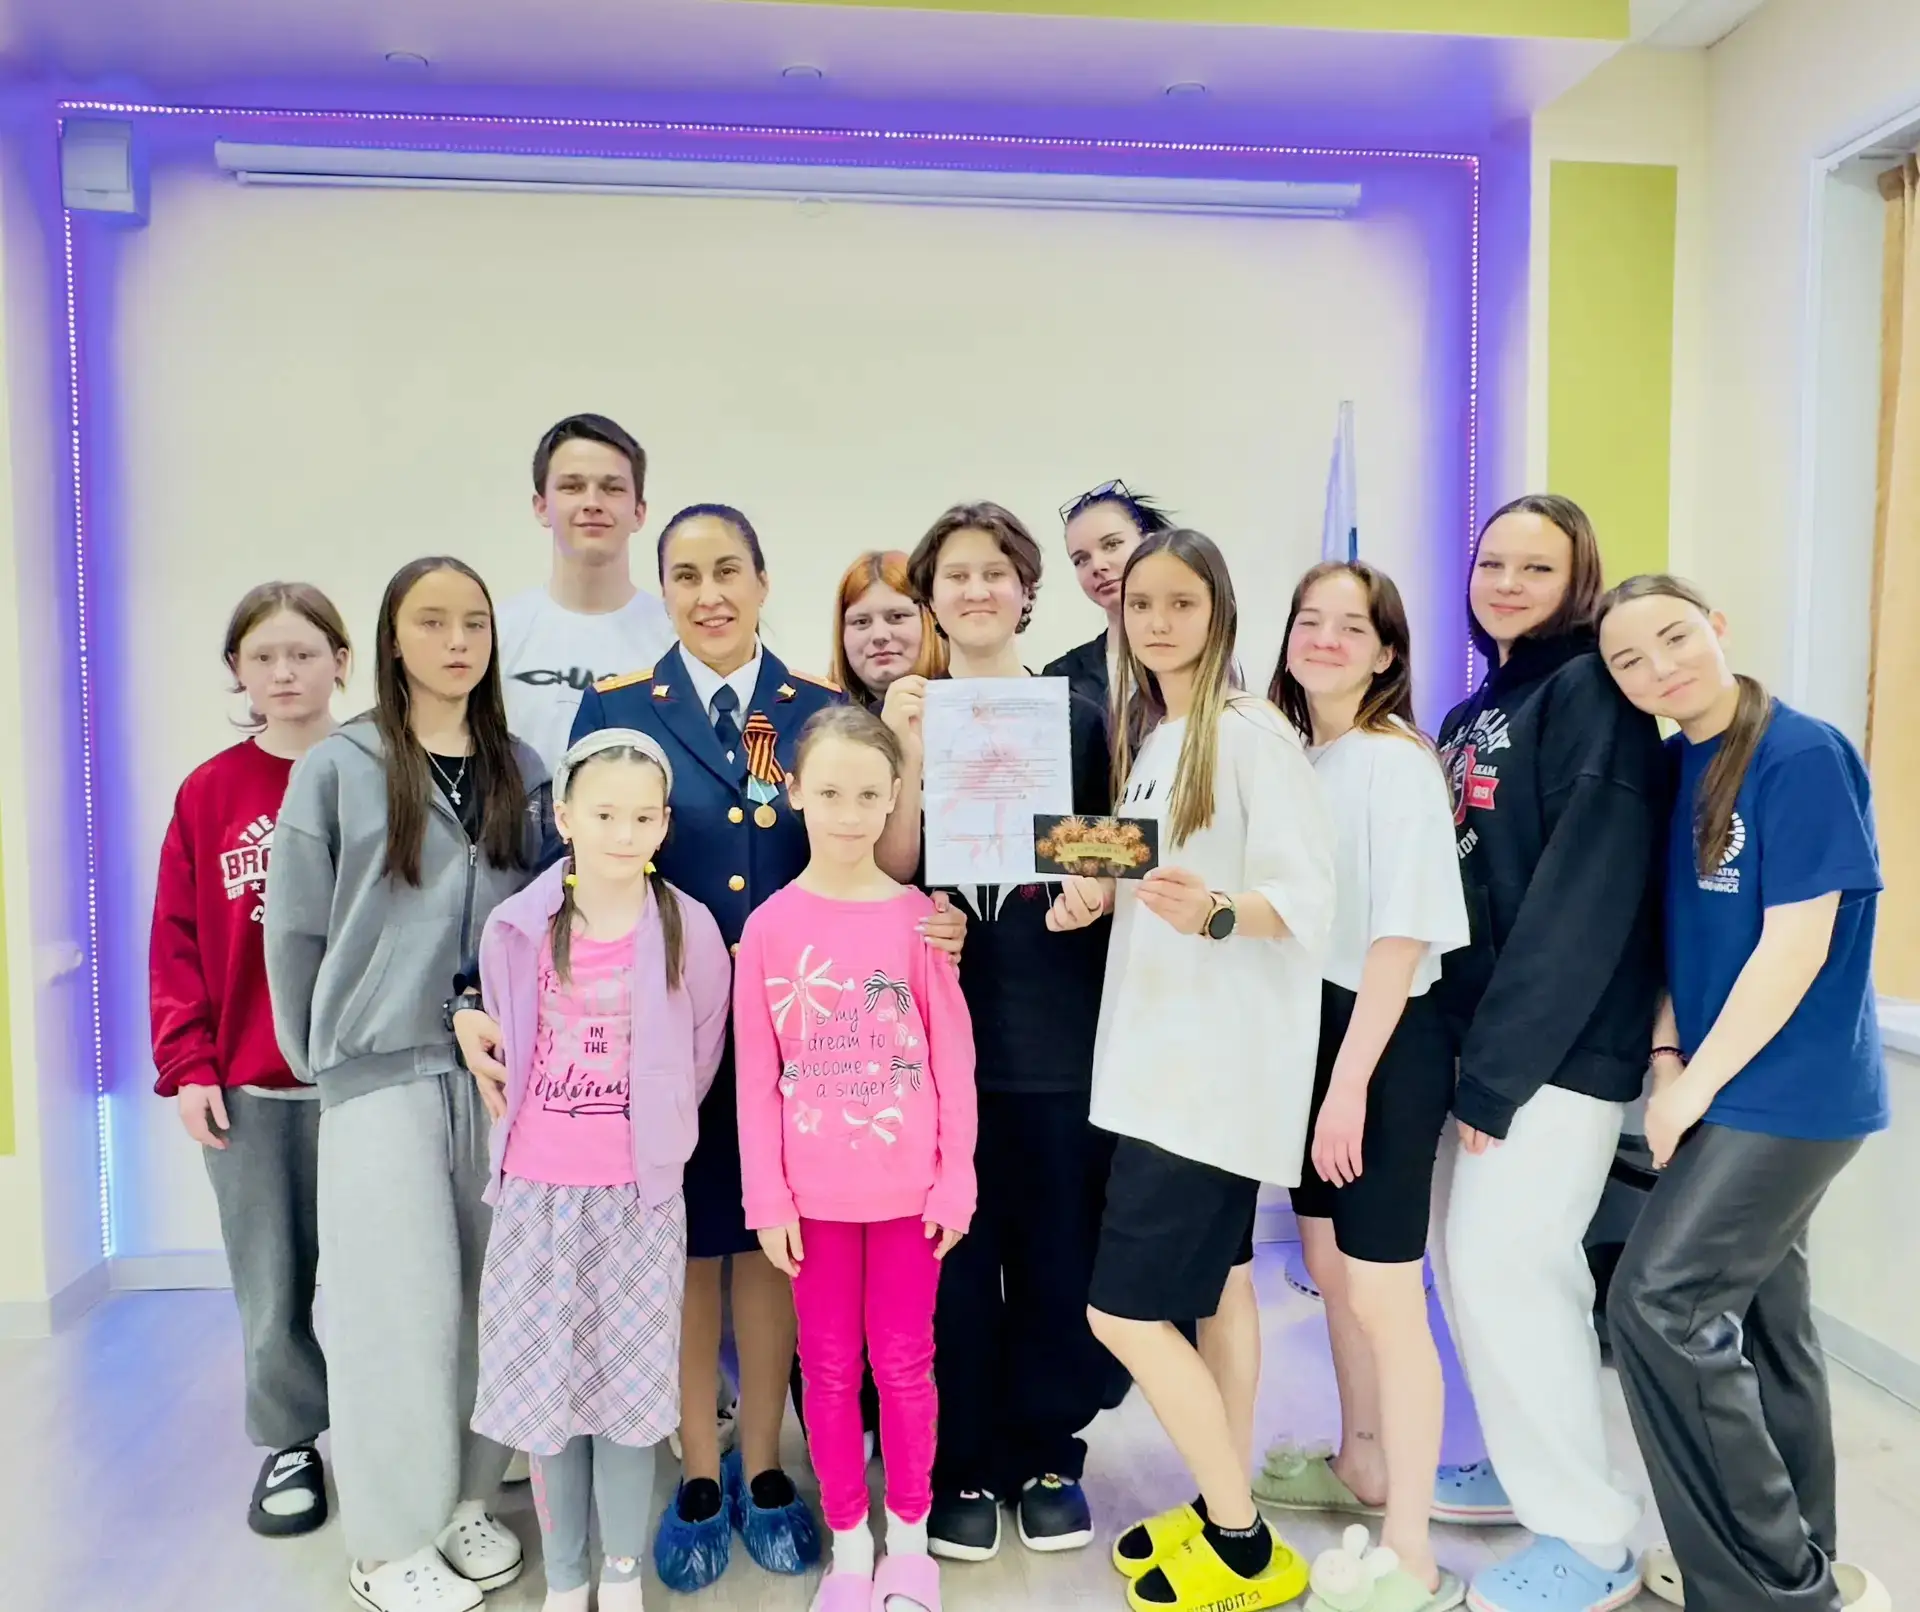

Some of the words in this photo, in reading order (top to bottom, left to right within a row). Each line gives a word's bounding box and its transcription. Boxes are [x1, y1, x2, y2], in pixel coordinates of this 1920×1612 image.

[835, 1008, 859, 1033] my
[589, 1026, 604, 1039] IN
[808, 1032, 860, 1052] dream
[870, 1029, 886, 1051] to
[583, 1041, 609, 1054] THE
[802, 1060, 863, 1079] become
[816, 1083, 828, 1099] a
[835, 1080, 887, 1107] singer
